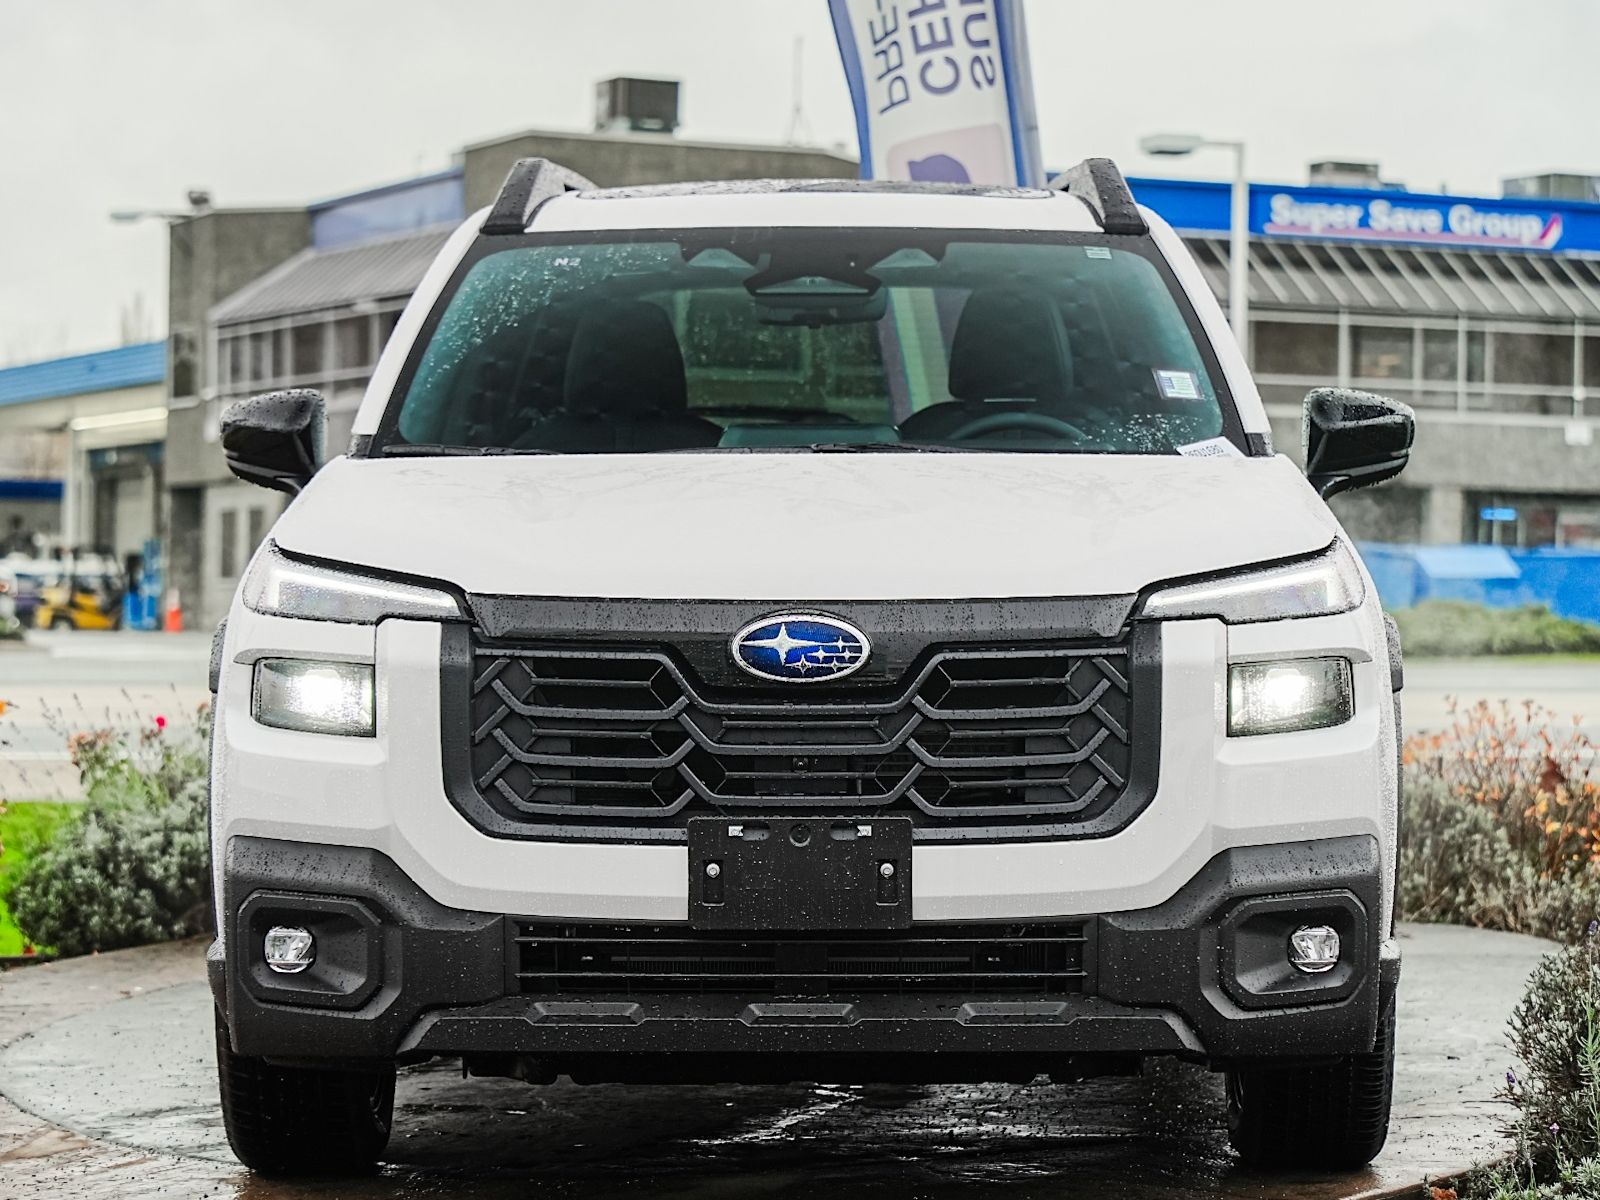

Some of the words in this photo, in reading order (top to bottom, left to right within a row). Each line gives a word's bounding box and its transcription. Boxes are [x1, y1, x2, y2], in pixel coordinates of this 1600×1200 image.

[1270, 193, 1364, 234] Super
[1368, 199, 1443, 234] Save
[1448, 204, 1543, 246] Group
